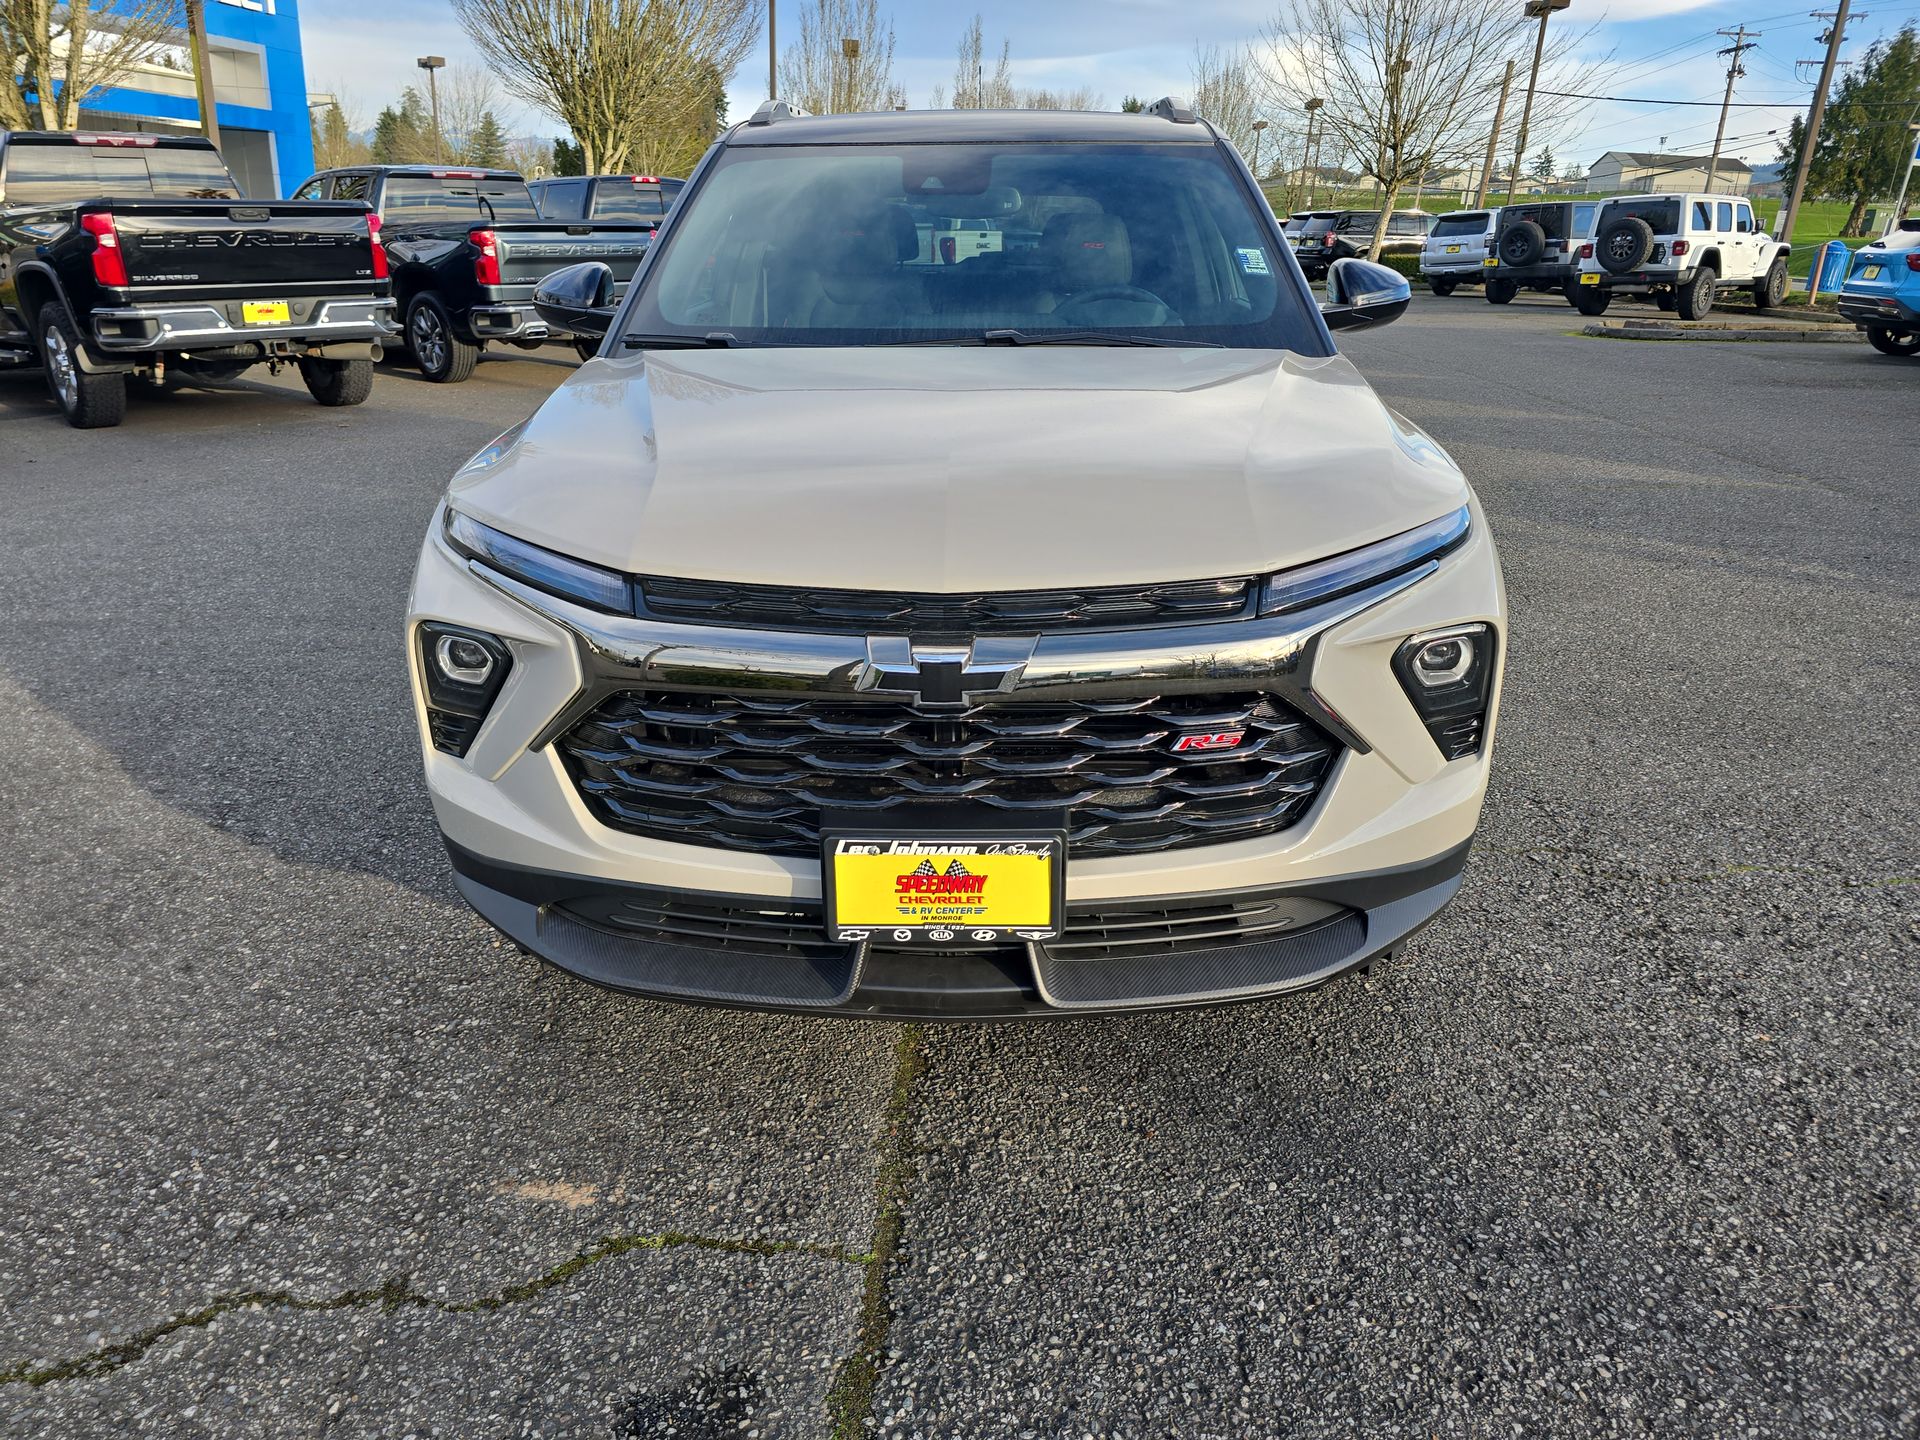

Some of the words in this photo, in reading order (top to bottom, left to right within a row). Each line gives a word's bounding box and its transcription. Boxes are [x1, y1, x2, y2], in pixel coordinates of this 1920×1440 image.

[139, 232, 357, 248] CHEVROLET
[511, 244, 646, 256] CHEVROLET
[1170, 731, 1245, 751] RS
[882, 840, 979, 855] Johnson
[895, 875, 988, 893] SPEEDWAY
[899, 896, 984, 904] CHEVROLET
